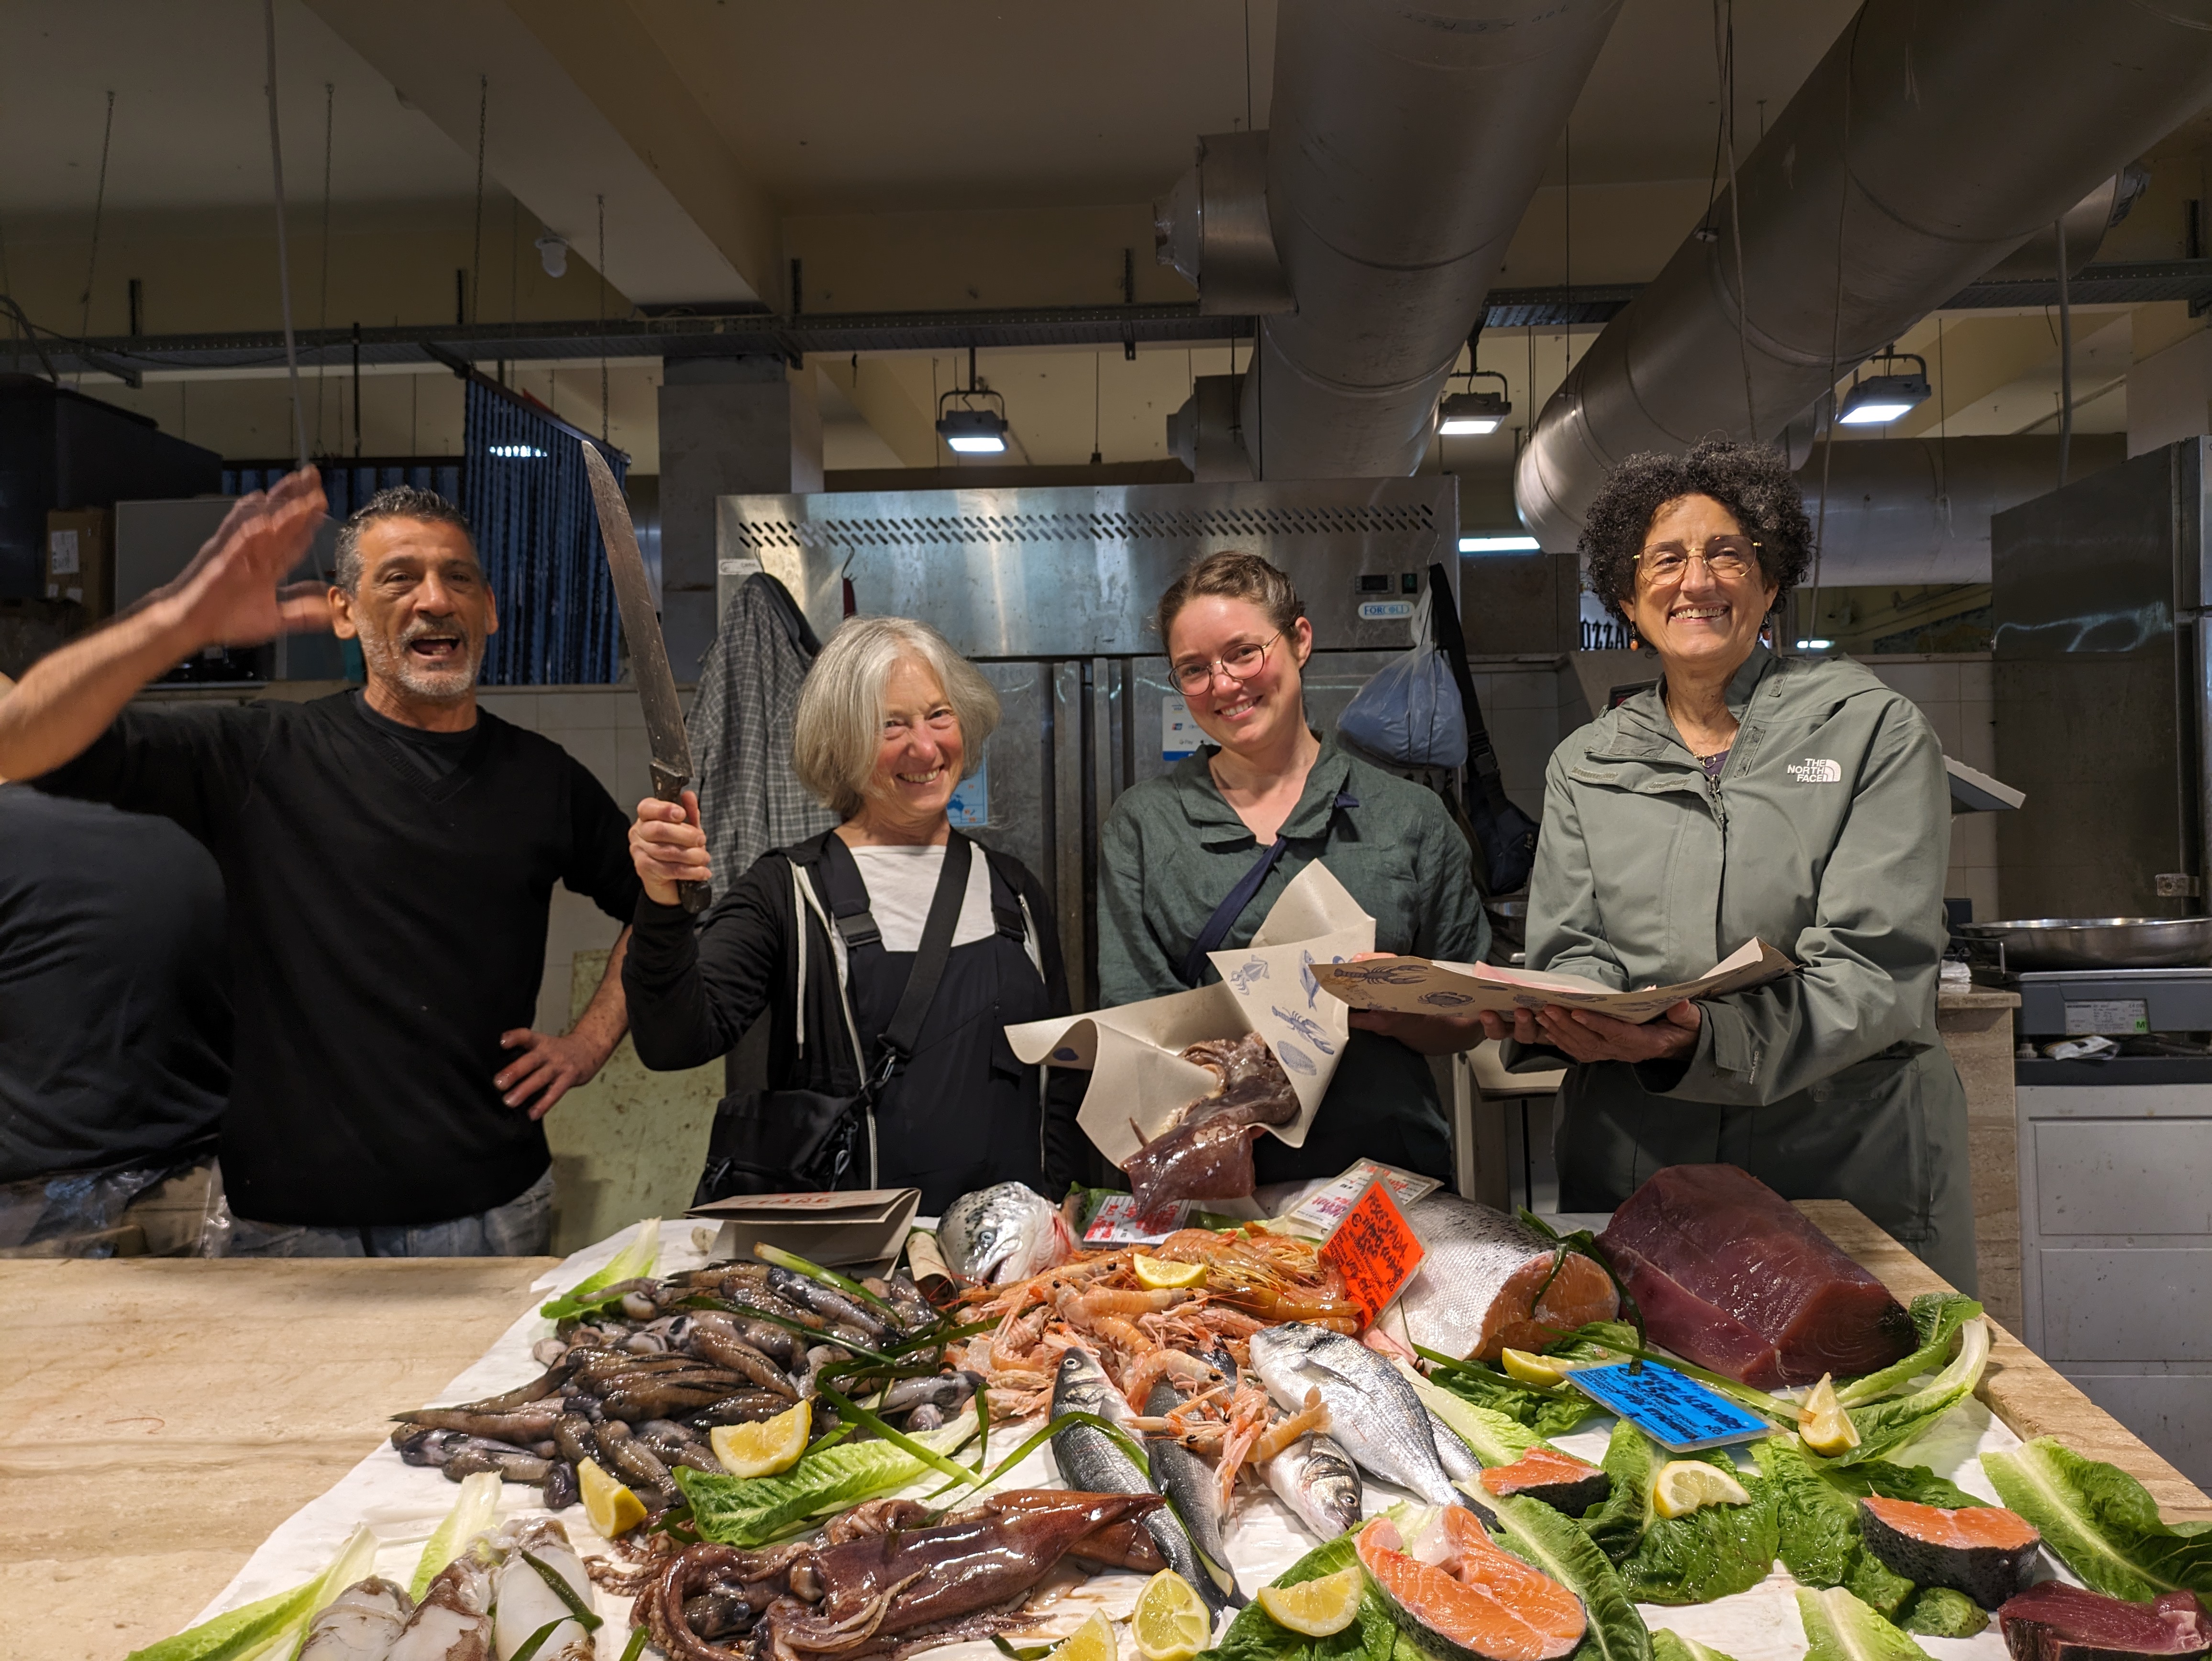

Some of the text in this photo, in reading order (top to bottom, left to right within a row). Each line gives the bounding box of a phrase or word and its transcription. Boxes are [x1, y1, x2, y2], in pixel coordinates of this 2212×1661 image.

[1787, 764, 1824, 774] NORTH
[1805, 758, 1826, 766] THE
[1797, 774, 1823, 782] FACE
[1351, 1213, 1362, 1227] €
[1330, 1240, 1345, 1265] DEFINIZIONE
[1337, 1240, 1348, 1260] CATTURA
[1363, 1256, 1383, 1289] PRODUZIONE
[1386, 1279, 1395, 1292] KG
[1371, 1284, 1384, 1304] ALLEVATO
[1652, 1398, 1699, 1428] PRODUZIONE
[1704, 1425, 1722, 1435] KG
